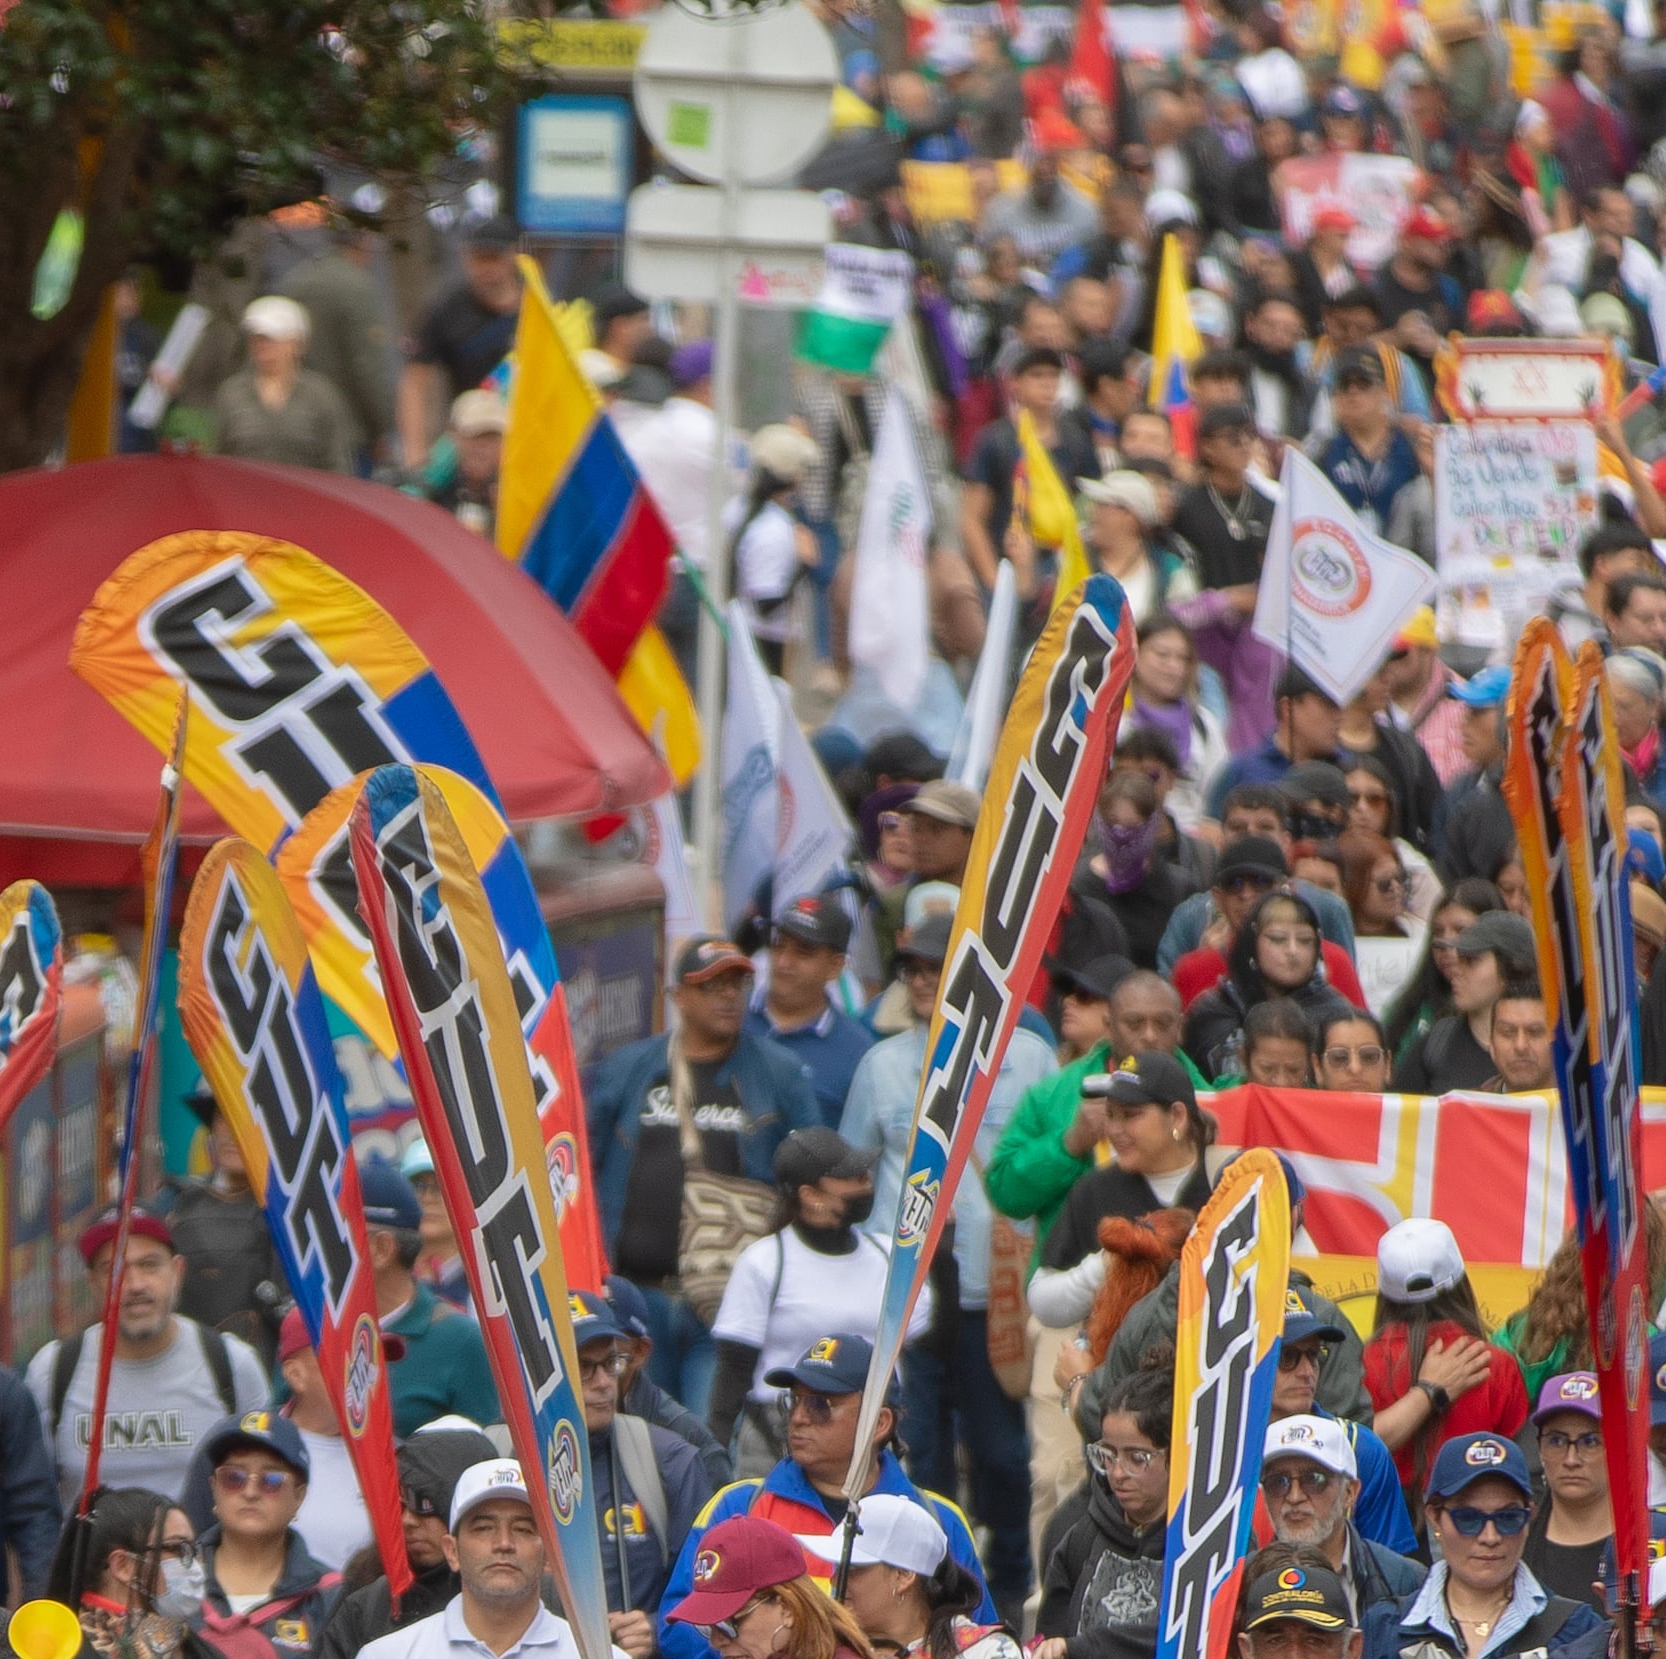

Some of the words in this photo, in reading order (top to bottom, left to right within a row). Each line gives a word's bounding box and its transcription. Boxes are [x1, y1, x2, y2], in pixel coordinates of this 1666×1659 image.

[201, 860, 359, 1328] CUT
[375, 797, 564, 1412] CUT
[920, 603, 1118, 1153] CUT
[75, 1410, 193, 1449] UNAL
